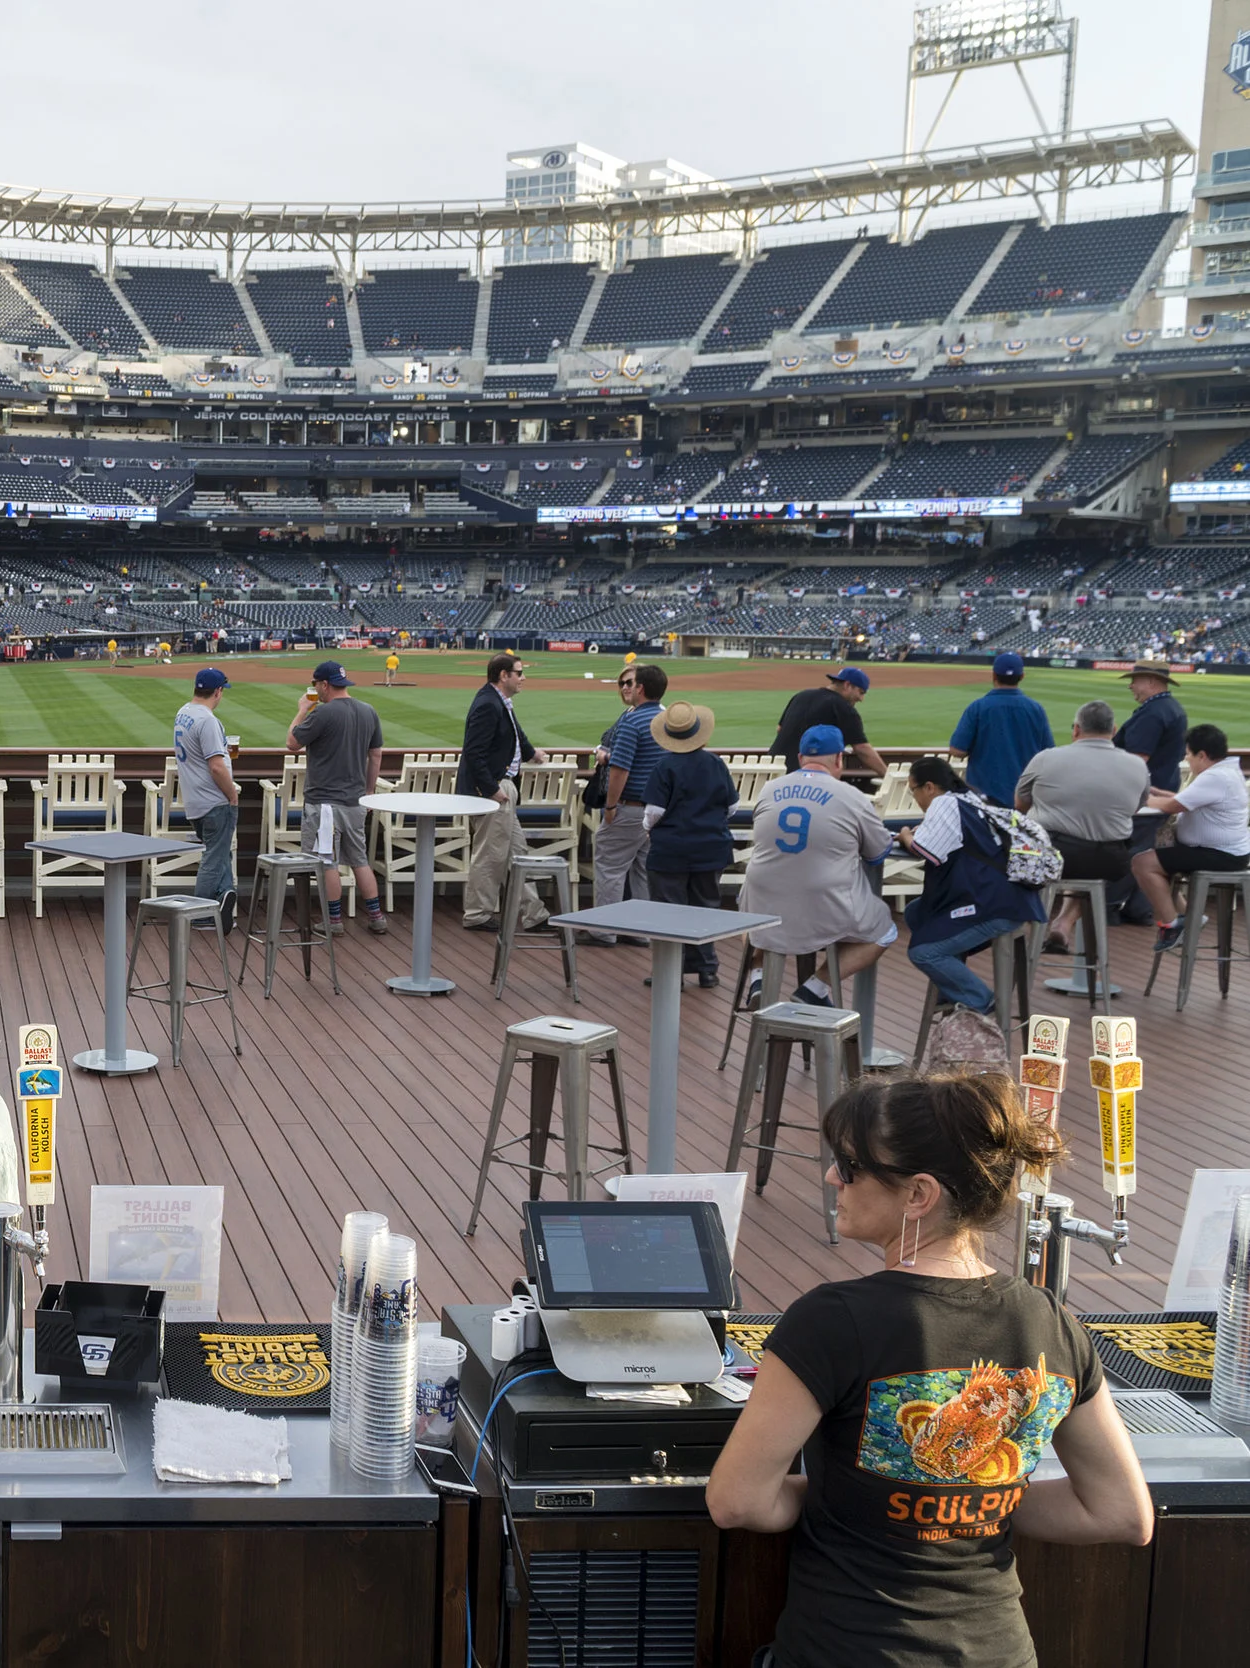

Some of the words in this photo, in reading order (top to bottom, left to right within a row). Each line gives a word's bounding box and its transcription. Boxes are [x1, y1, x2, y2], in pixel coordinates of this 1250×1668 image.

[128, 389, 143, 397] TONY
[482, 391, 507, 399] TREVOR
[518, 391, 549, 399] HOFFMAN
[577, 389, 598, 397] JACKIE
[610, 387, 643, 395] ROBINSON
[194, 412, 235, 421] JERRY
[240, 412, 304, 421] COLEMAN
[308, 412, 390, 421] BROADCAST
[396, 412, 450, 421] CENTER
[86, 507, 116, 517] OPENING
[117, 507, 136, 518] WEEK
[913, 502, 958, 514] OPENING
[960, 500, 988, 512] WEEK
[565, 508, 604, 519] OPENING
[605, 508, 629, 519] WEEK
[175, 730, 187, 762] 5
[773, 785, 834, 806] GORDON
[775, 806, 811, 854] 9
[1032, 1037, 1058, 1047] BALLAST
[1036, 1042, 1055, 1052] POINT
[24, 1047, 53, 1055] BALLAST
[1119, 1102, 1127, 1155] PINEAPPLE
[30, 1107, 40, 1164] CALIFORNIA
[382, 1300, 401, 1309] AME
[1116, 1330, 1206, 1339] POINT
[218, 1342, 304, 1353] POINT
[1114, 1338, 1217, 1351] ALLAST
[205, 1351, 330, 1364] BALLAST
[624, 1364, 656, 1373] micros
[539, 1493, 589, 1507] Perlick
[886, 1484, 1029, 1525] SCULPIN
[917, 1527, 950, 1541] INDIA
[952, 1525, 981, 1538] PALE
[982, 1521, 1000, 1537] ALE
